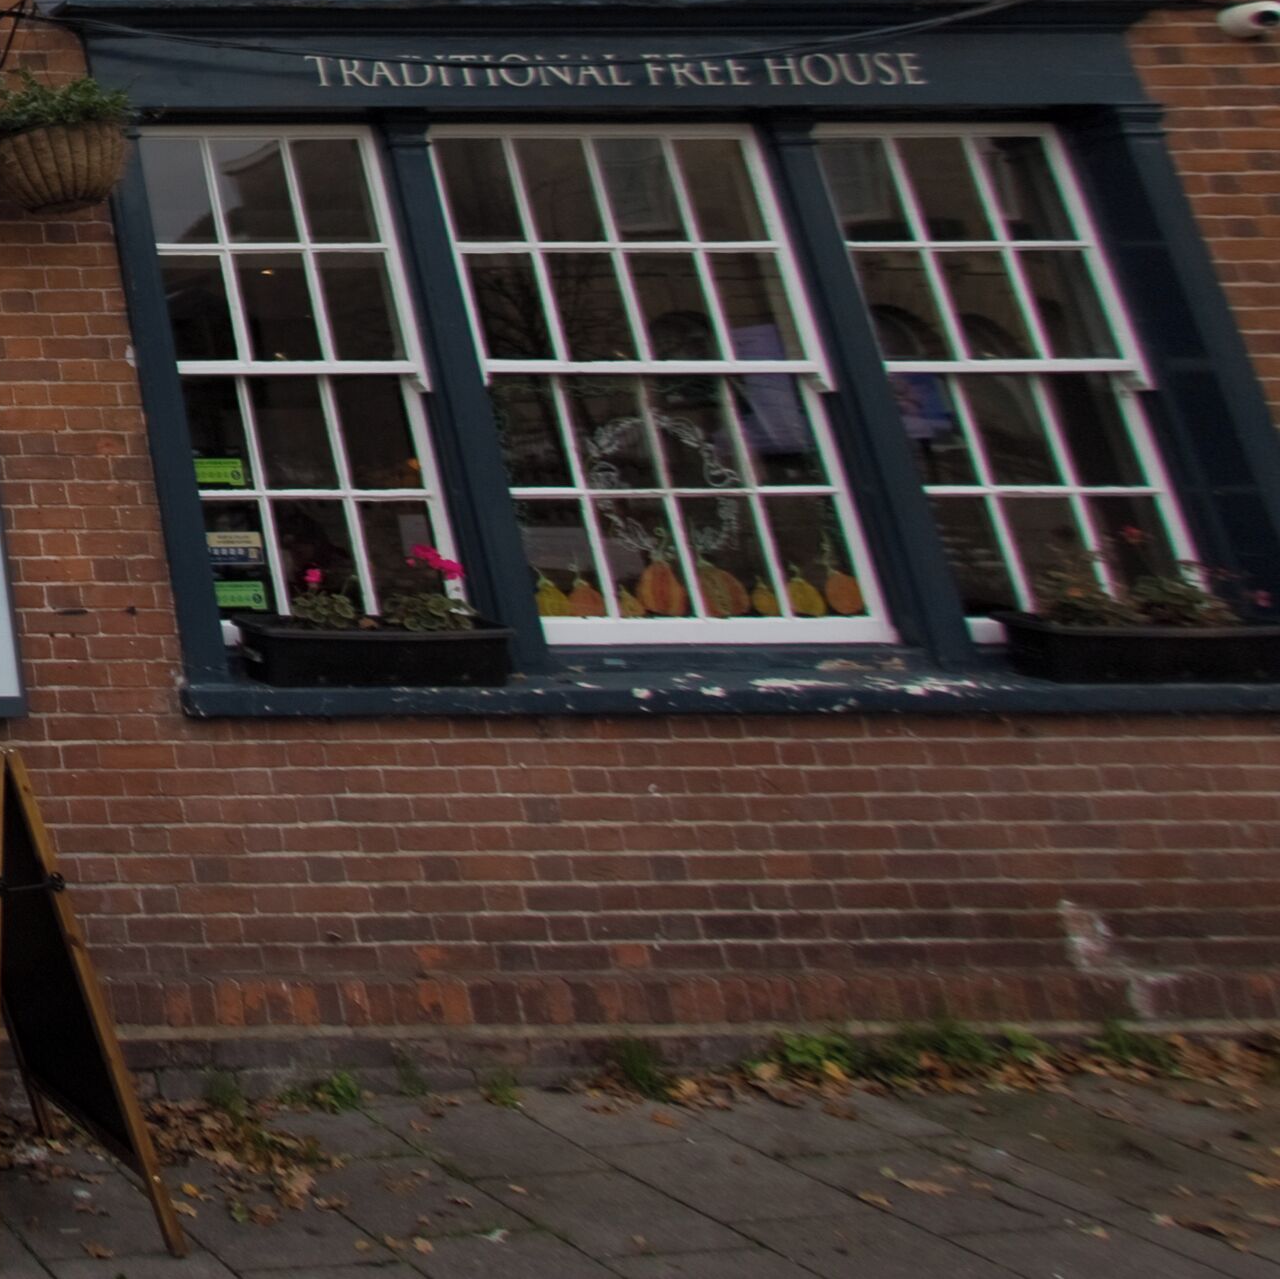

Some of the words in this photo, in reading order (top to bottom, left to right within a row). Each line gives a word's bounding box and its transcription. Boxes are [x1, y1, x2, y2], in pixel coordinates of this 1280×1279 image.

[304, 53, 633, 87] TRADITIONAL
[641, 53, 752, 87] FREE
[763, 52, 928, 86] HOUSE
